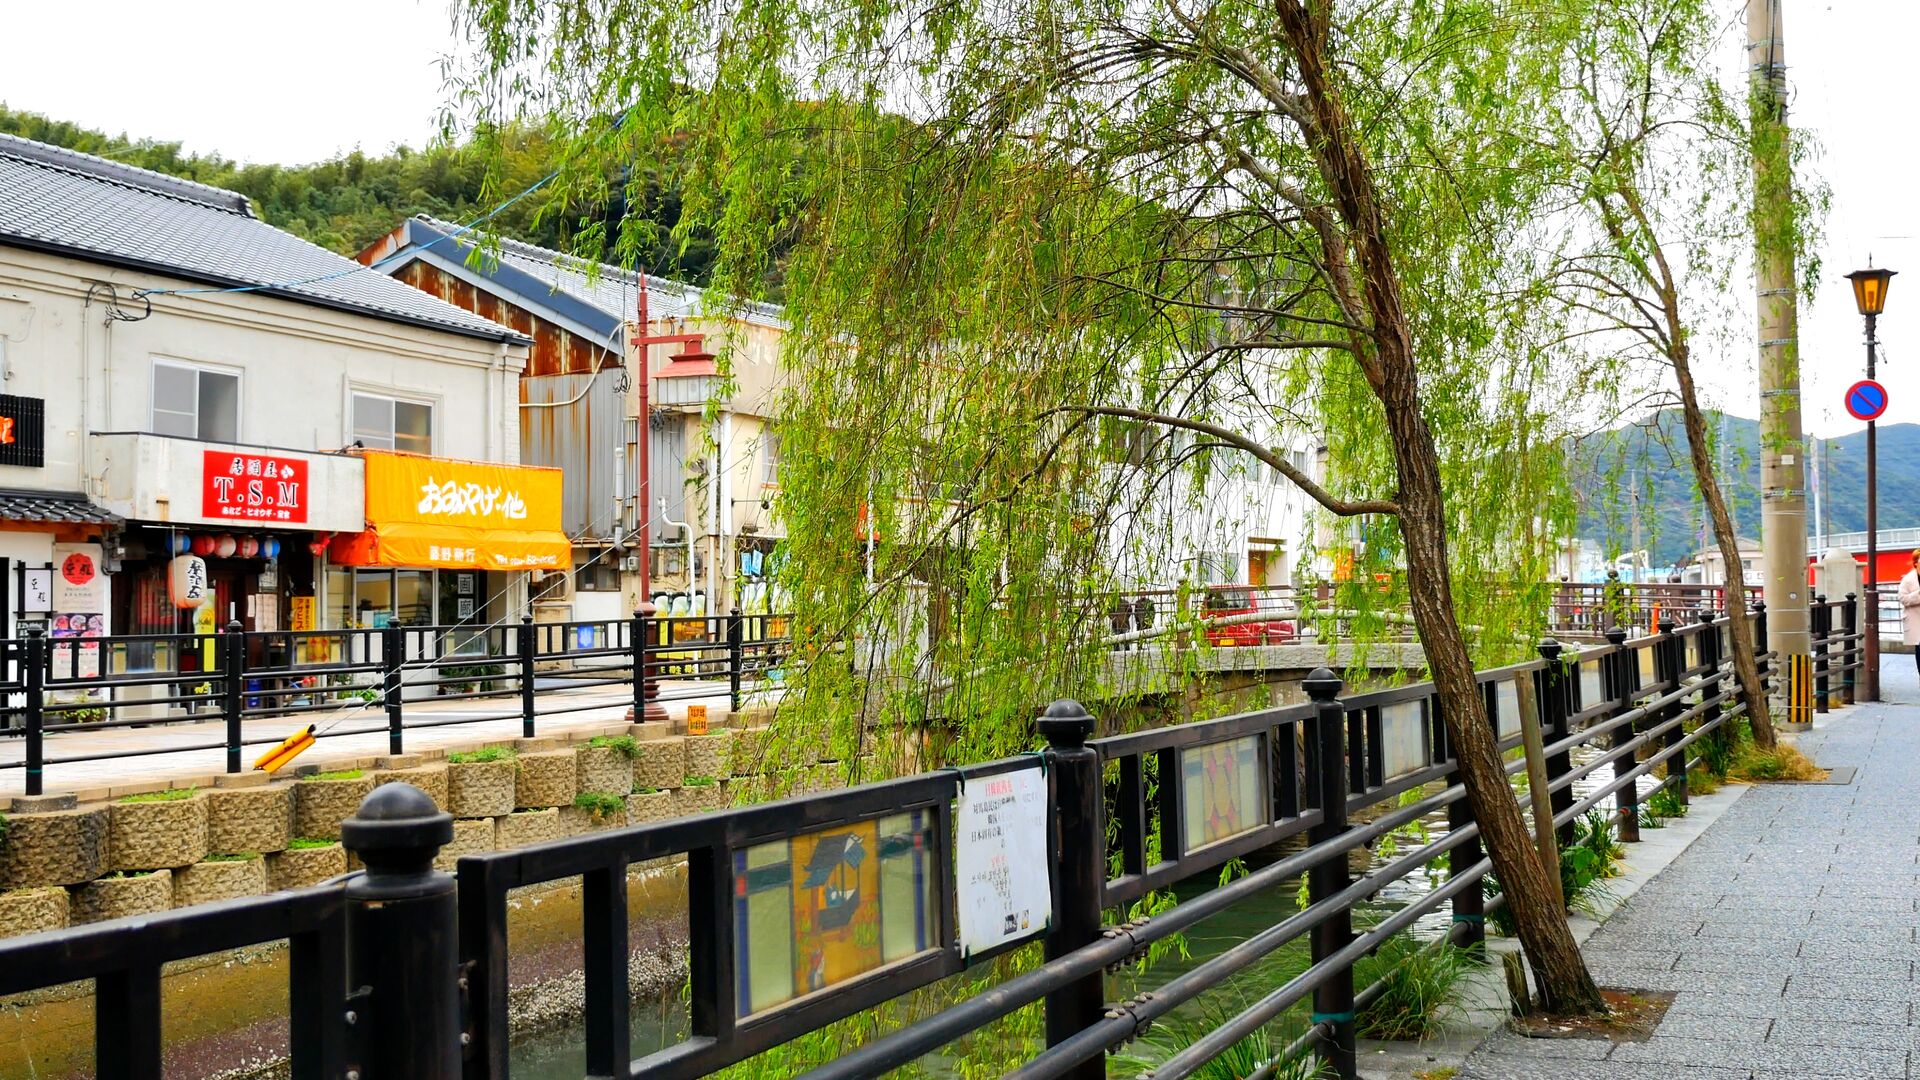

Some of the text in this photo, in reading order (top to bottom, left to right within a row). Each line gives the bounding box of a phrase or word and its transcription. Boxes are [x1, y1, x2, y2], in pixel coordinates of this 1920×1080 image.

[229, 457, 278, 478] 居酒屋
[214, 476, 299, 508] T.S.M
